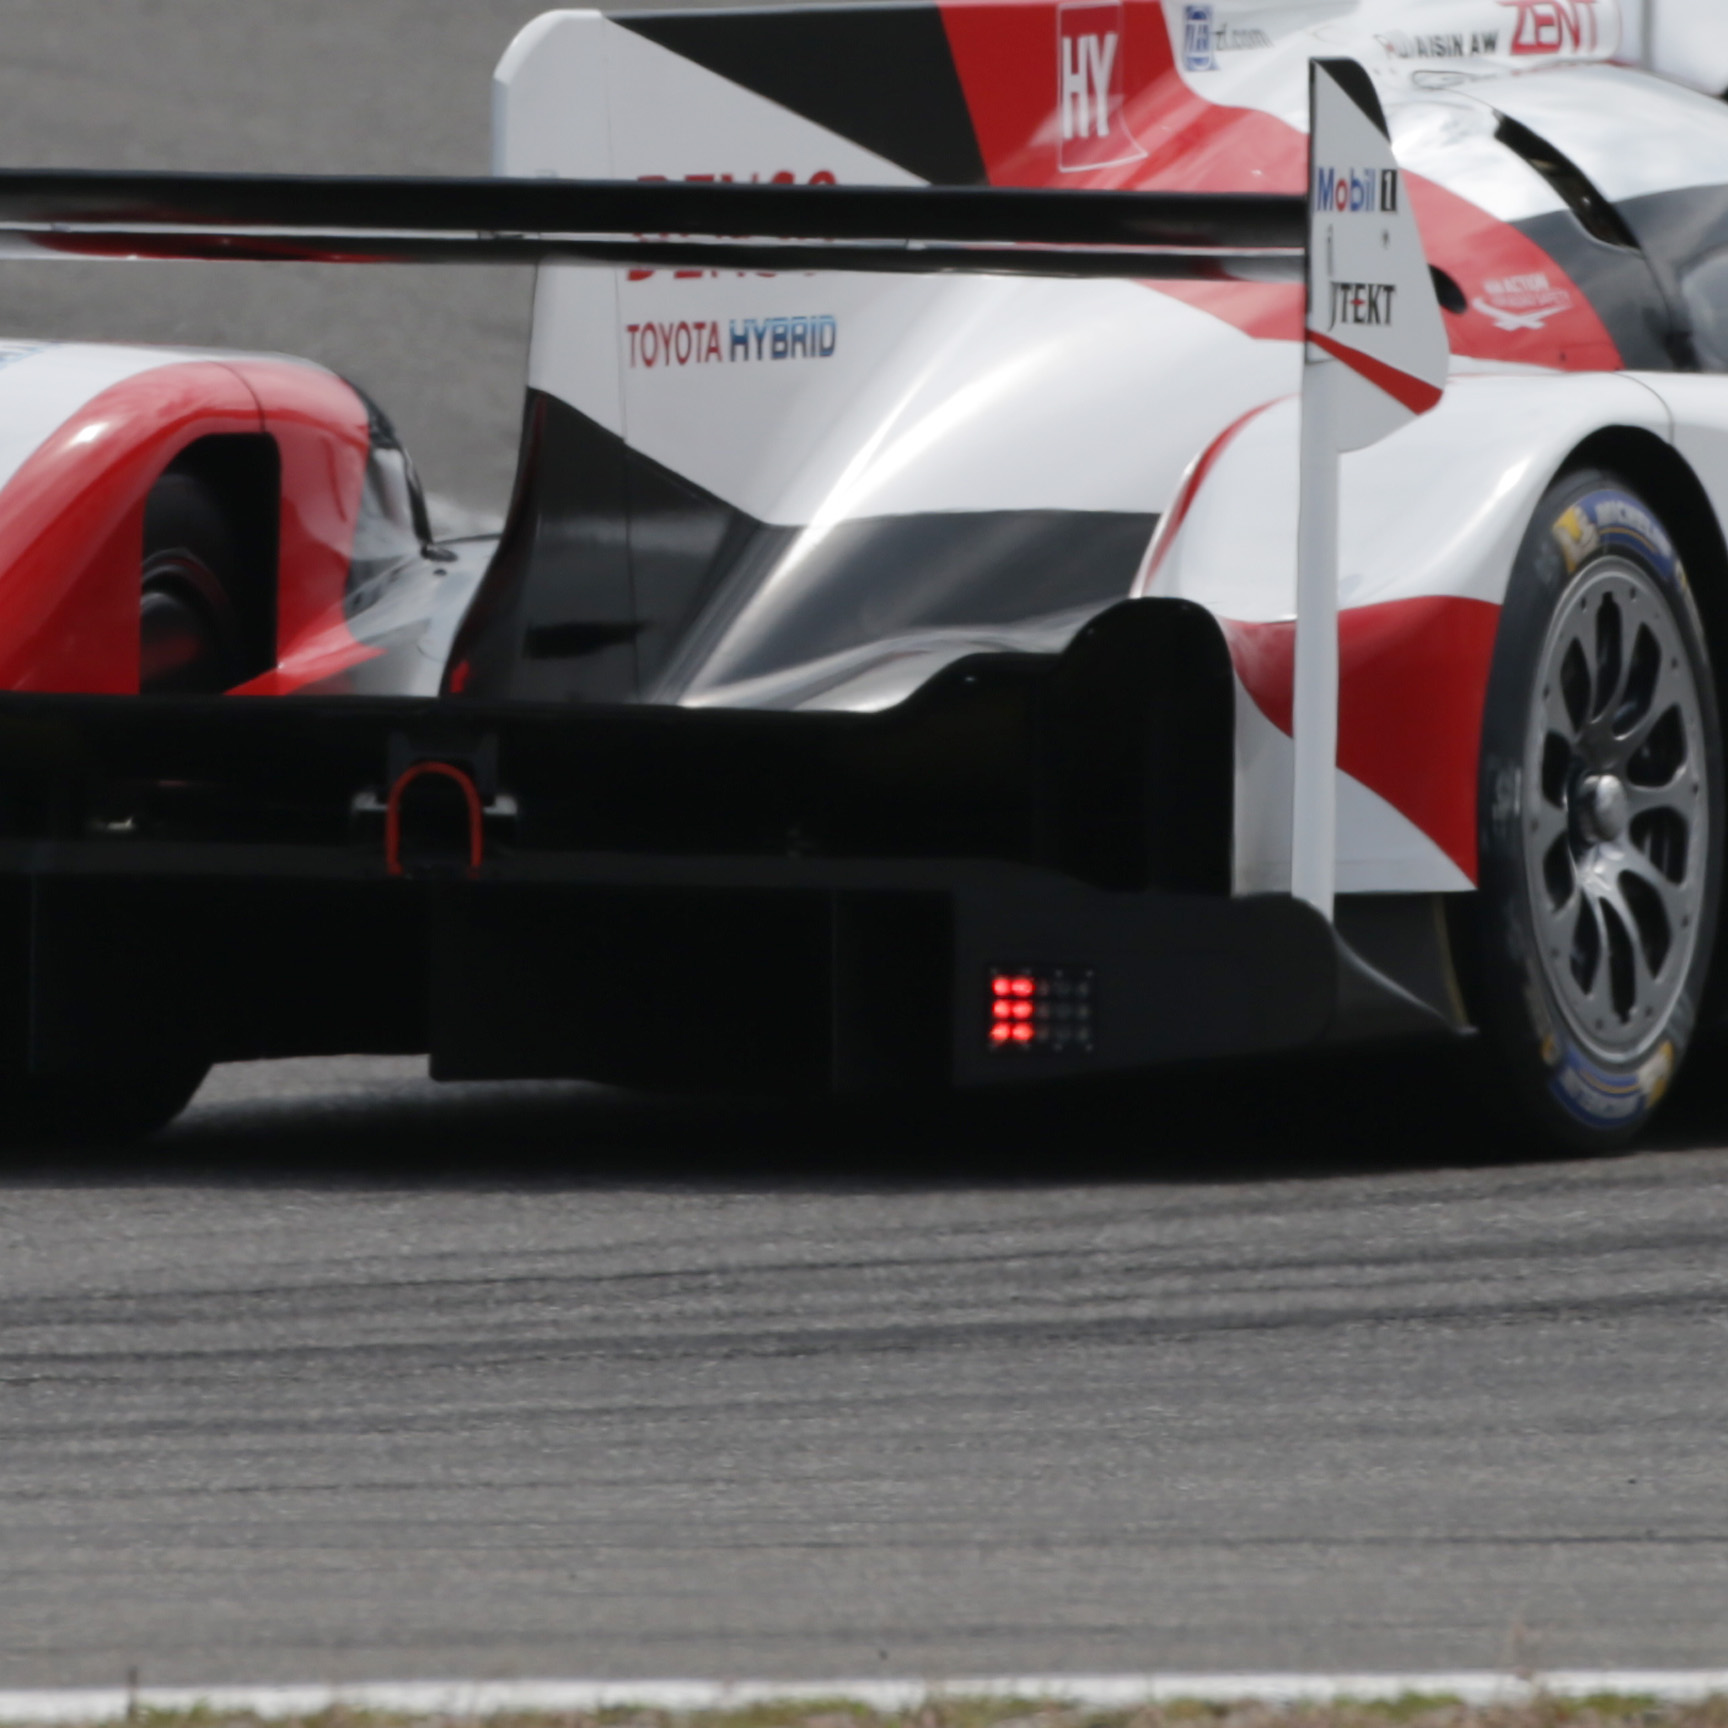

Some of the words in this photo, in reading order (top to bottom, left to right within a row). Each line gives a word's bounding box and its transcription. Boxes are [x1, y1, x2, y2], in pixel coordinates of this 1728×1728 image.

[1414, 32, 1464, 58] AISIN
[1470, 29, 1500, 55] AW
[1062, 30, 1119, 140] HY
[1317, 168, 1376, 213] Mobil
[1327, 280, 1396, 332] JTEKT
[626, 320, 722, 369] TOYOTA
[728, 314, 837, 363] HYBRID
